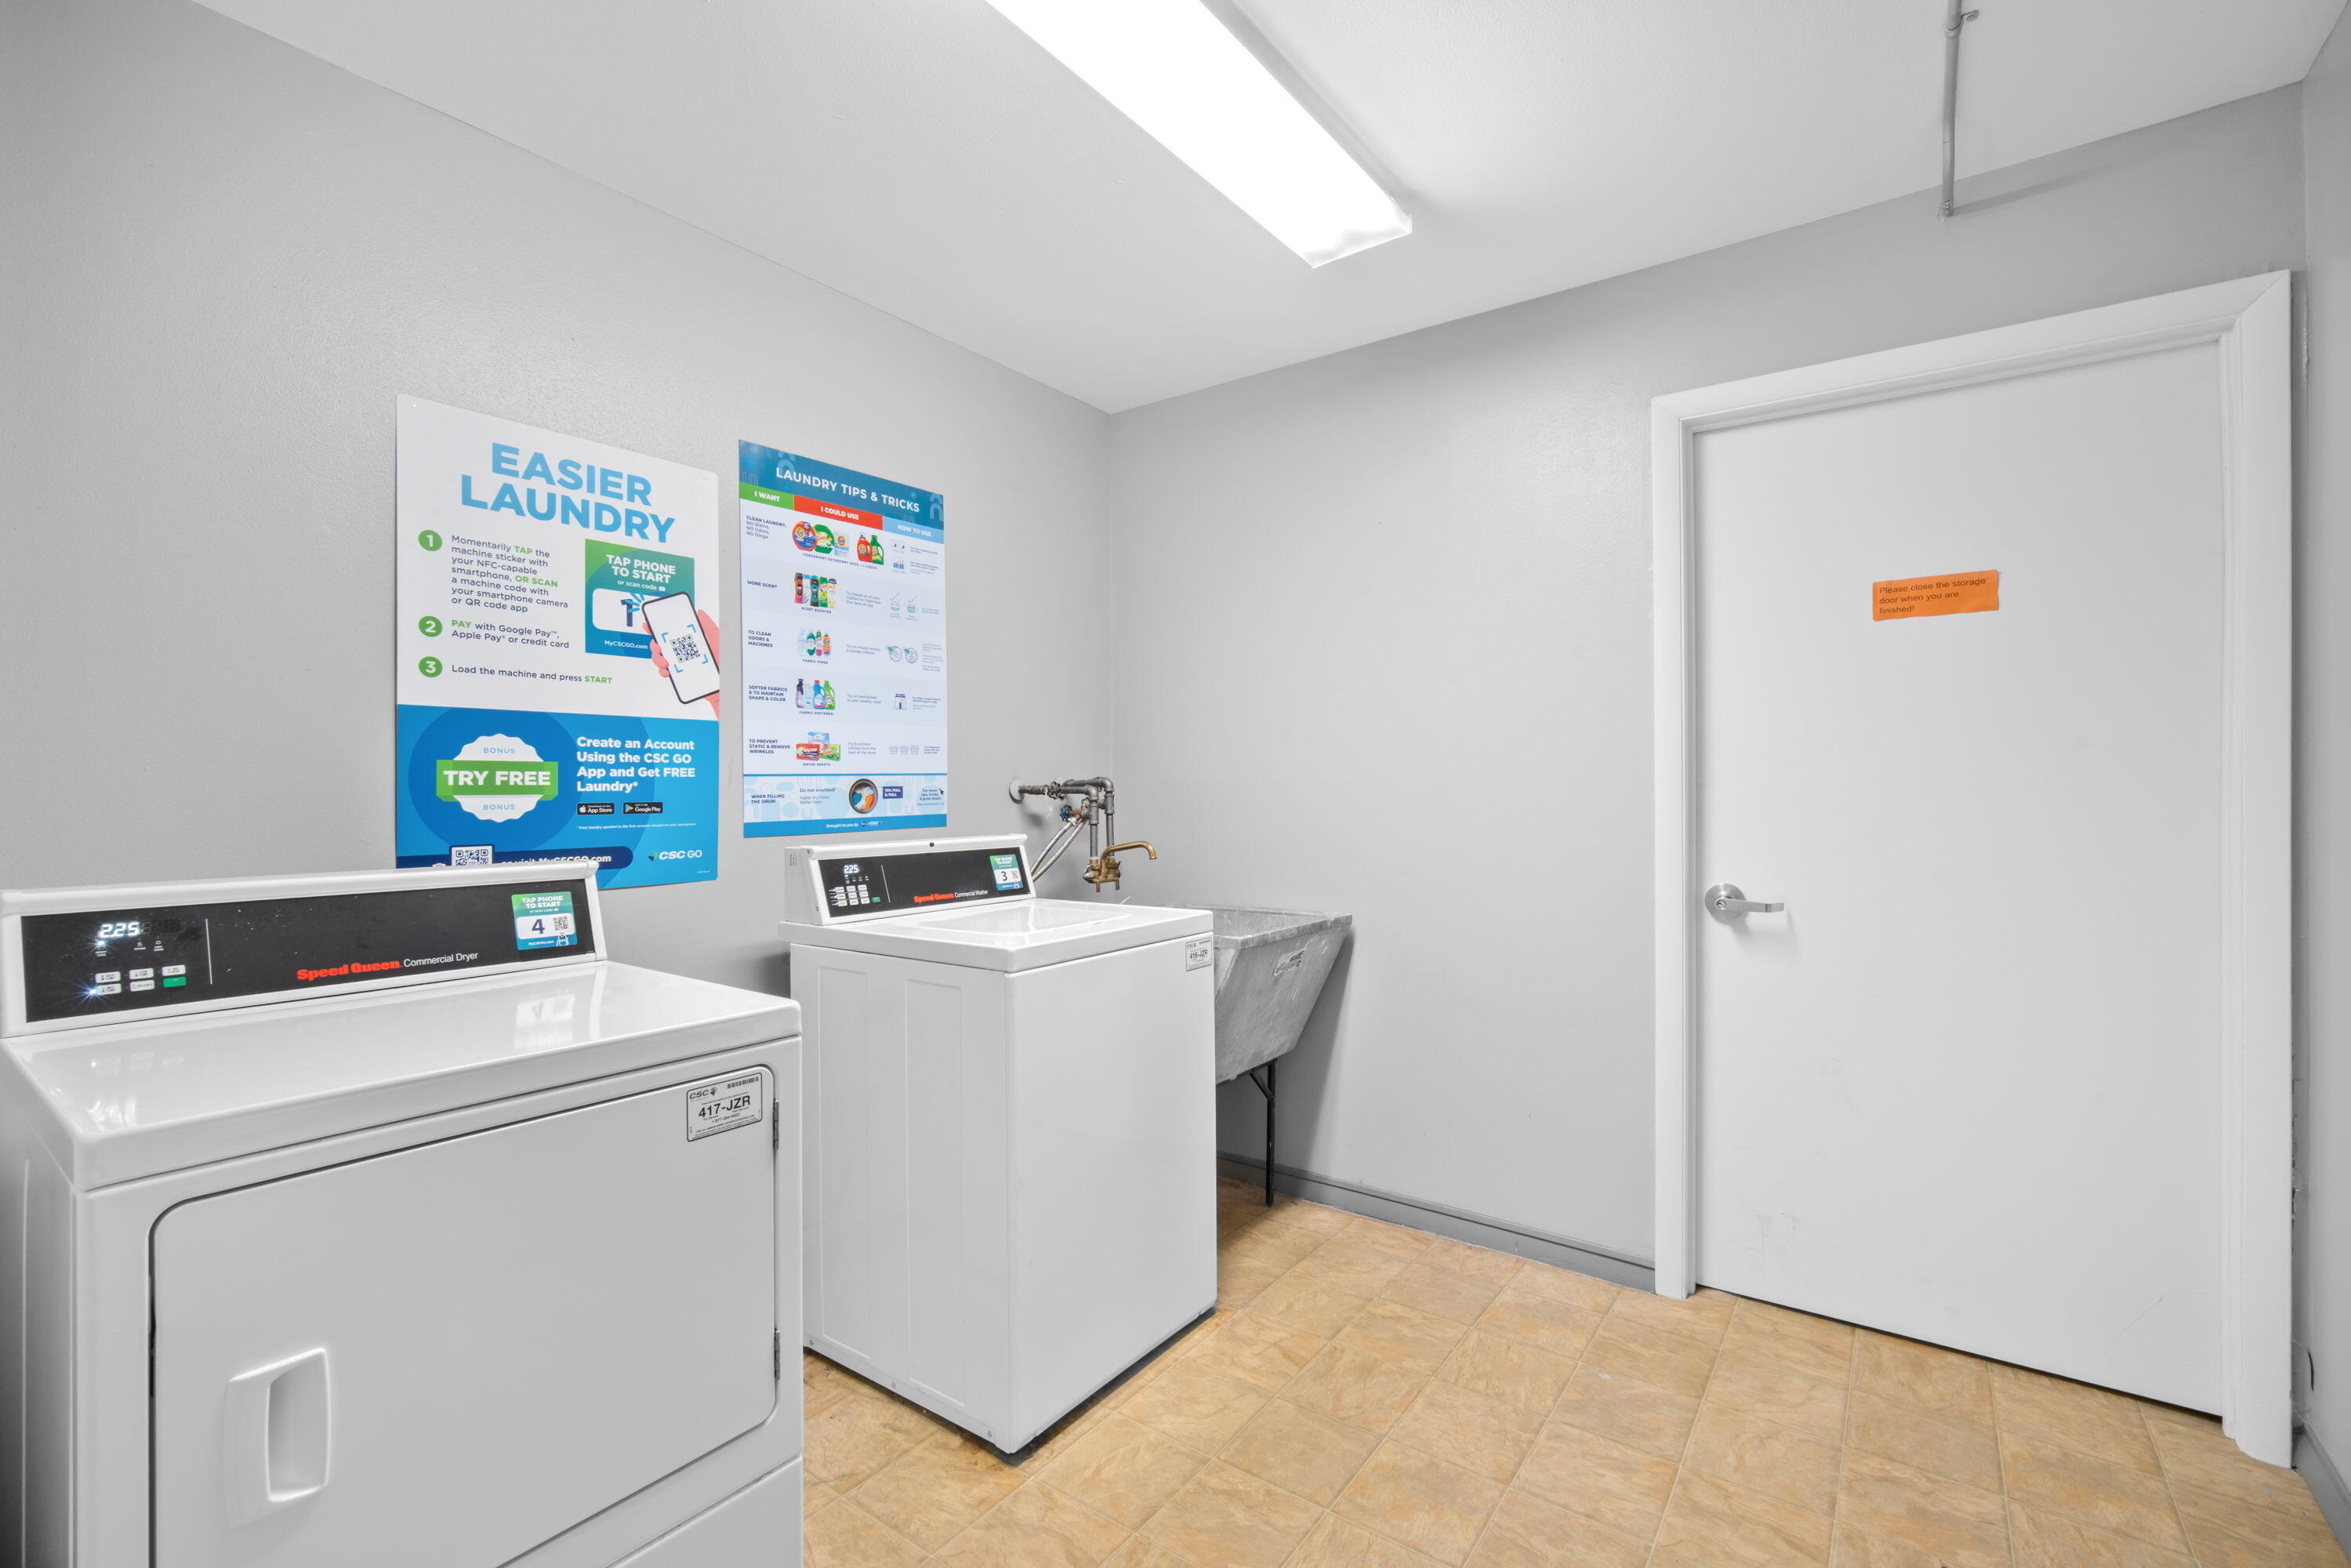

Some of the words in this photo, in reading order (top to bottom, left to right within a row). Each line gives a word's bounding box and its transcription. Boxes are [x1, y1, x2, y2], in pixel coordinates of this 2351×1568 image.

[492, 442, 651, 506] EASIER
[759, 492, 780, 502] WANT
[776, 467, 838, 492] LAUNDRY
[841, 483, 867, 499] TIPS
[871, 492, 878, 502] &
[881, 494, 920, 513] TRICKS
[462, 474, 675, 543] LAUNDRY
[825, 507, 846, 517] COULD
[426, 535, 433, 546] 1
[452, 535, 511, 552] Momentarily
[513, 546, 532, 554] TAP
[535, 550, 550, 558] the
[452, 546, 492, 558] machine
[495, 554, 526, 564] sticker
[529, 558, 548, 567] with
[828, 556, 849, 564] DETERGENT
[477, 560, 537, 575] NFC-capable
[607, 554, 630, 566] TAP
[634, 559, 676, 575] PHONE
[452, 567, 512, 582] smartphone,
[515, 575, 529, 584] OR
[532, 578, 558, 588] SCAN
[612, 566, 629, 577] TO
[633, 570, 671, 583] START
[461, 577, 501, 589] machine
[505, 584, 527, 593] code
[530, 587, 549, 596] with
[1952, 578, 1986, 588] storage
[452, 587, 473, 596] your
[477, 590, 533, 604] smartphone
[536, 599, 568, 608] camera
[466, 597, 481, 607] QR
[484, 601, 507, 610] code
[1900, 594, 1924, 603] when
[1926, 593, 1942, 602] you
[621, 599, 633, 627] 1
[1880, 605, 1914, 615] finished!
[426, 621, 436, 633] 2
[452, 619, 471, 628] PAY
[475, 622, 495, 631] with
[499, 625, 532, 636] Google
[452, 630, 481, 640] Apple
[521, 637, 547, 646] credit
[604, 640, 648, 650] MyCSCGO.com
[426, 661, 435, 673] 3
[452, 665, 477, 674] Load
[480, 667, 495, 676] the
[499, 668, 537, 679] machine
[540, 671, 557, 681] and
[584, 675, 612, 684] START
[577, 736, 622, 748] Create
[625, 740, 640, 749] an
[644, 739, 695, 750] Account
[577, 751, 615, 764] Using
[619, 752, 640, 763] the
[644, 753, 669, 764] CSC
[673, 753, 692, 764] GO
[443, 770, 489, 786] TRY
[495, 771, 551, 786] FREE
[576, 766, 606, 779] App
[609, 767, 634, 777] and
[637, 767, 660, 777] Get
[663, 767, 695, 778] FREE
[659, 851, 686, 860] CSC
[687, 849, 702, 858] GO
[1001, 871, 1007, 881] 3
[913, 894, 934, 903] Speed
[532, 919, 545, 935] 4
[296, 964, 349, 981] Speed
[350, 960, 401, 974] Queen
[404, 954, 454, 967] Commercial
[455, 952, 478, 962] Dryer
[690, 1090, 709, 1099] CSC
[698, 1095, 750, 1118] 417-JZR
